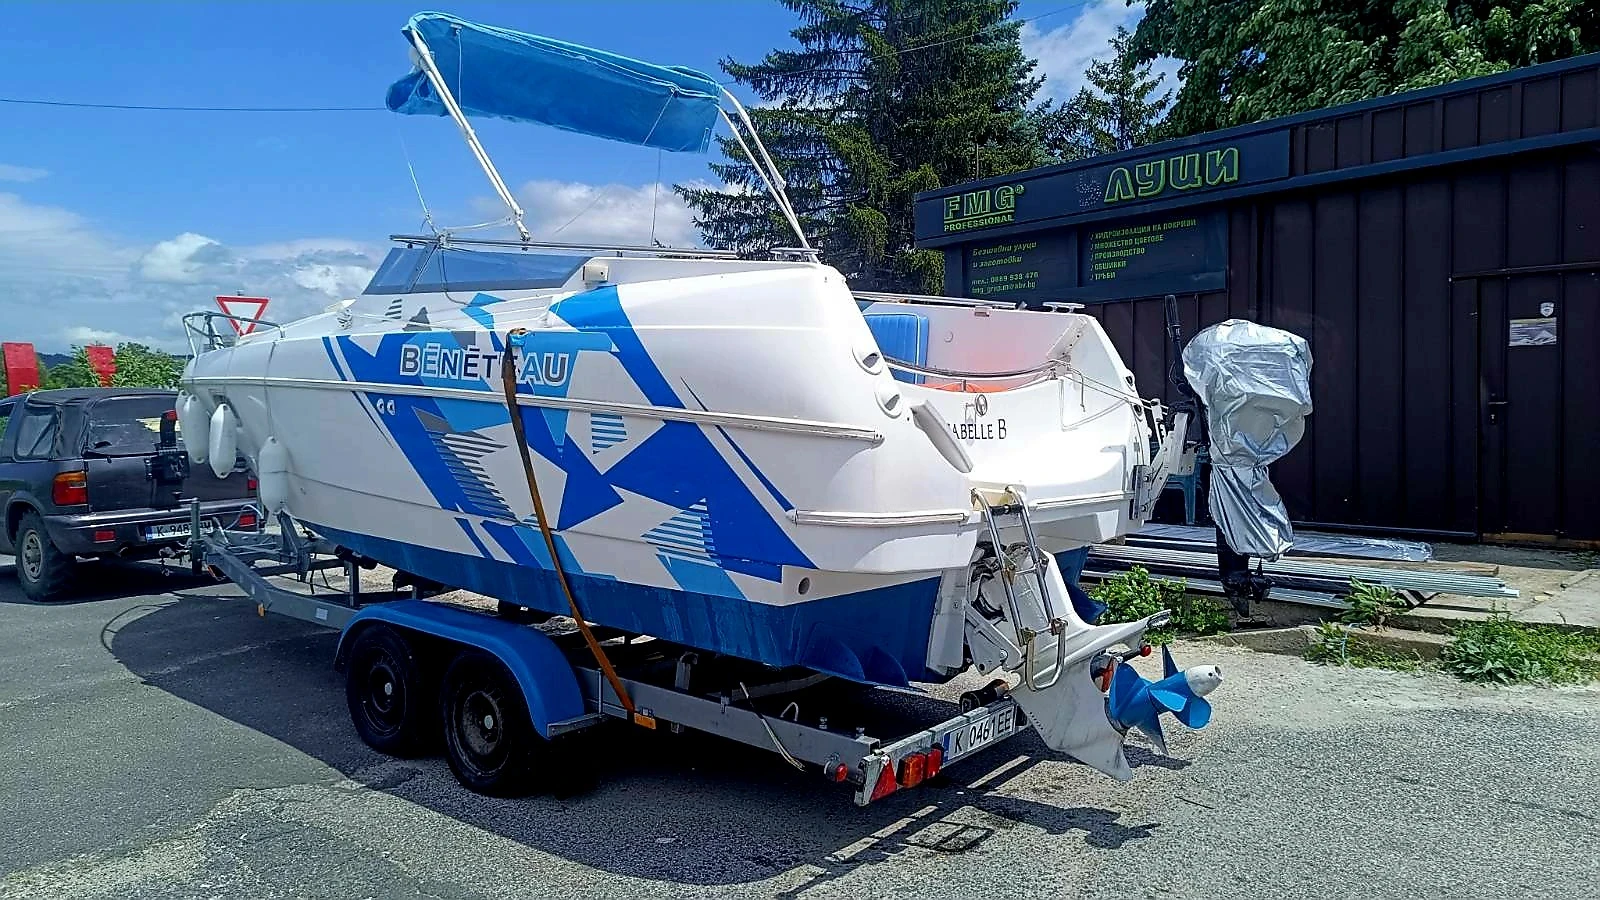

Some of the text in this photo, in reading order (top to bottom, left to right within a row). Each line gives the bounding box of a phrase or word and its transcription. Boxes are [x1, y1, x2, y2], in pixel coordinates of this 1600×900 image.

[944, 215, 1014, 232] PROFESSIONAL
[1094, 247, 1145, 260] ПРОИЗВОДСТВО
[947, 418, 1007, 440] ABELLE B
[954, 730, 964, 754] K
